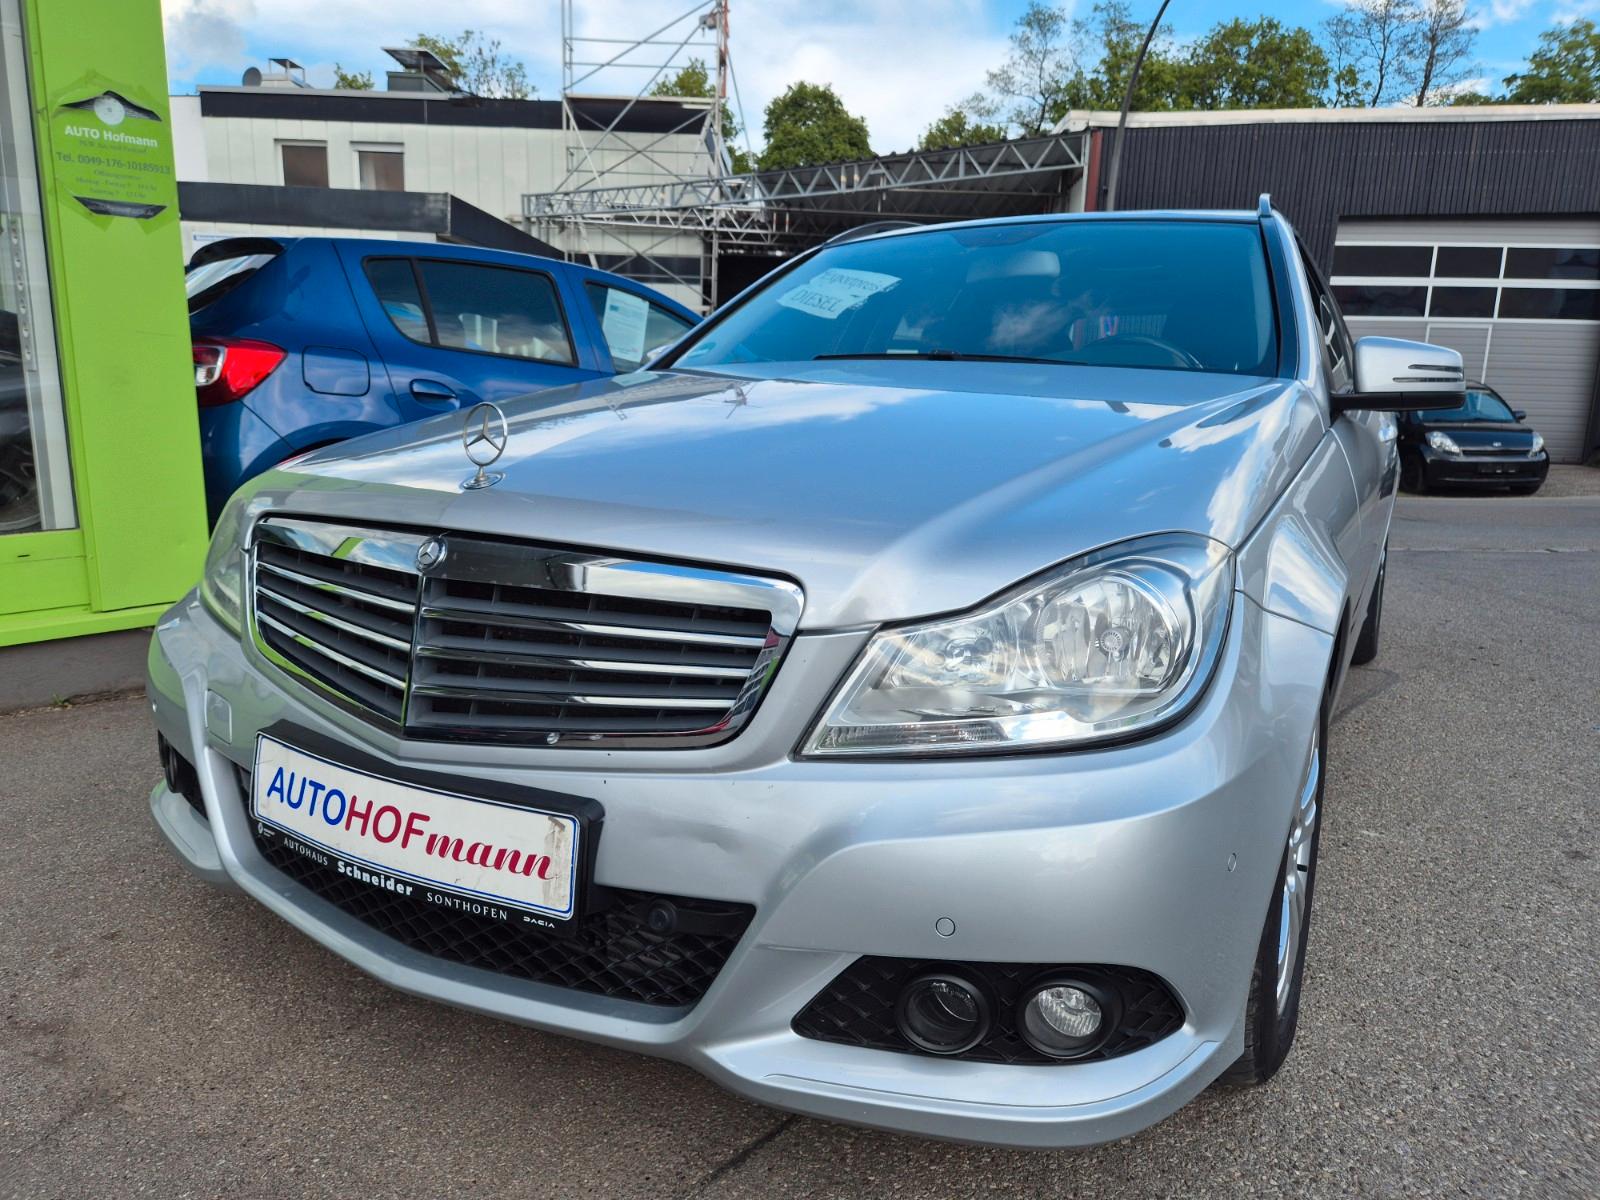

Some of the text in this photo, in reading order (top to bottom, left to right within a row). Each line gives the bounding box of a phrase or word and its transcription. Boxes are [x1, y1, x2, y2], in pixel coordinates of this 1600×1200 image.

[64, 125, 100, 139] AUTO
[103, 130, 158, 147] Hofmann
[55, 152, 74, 163] Tel.
[791, 288, 843, 313] DIESEL
[283, 837, 508, 921] AUTOHAUS Schneider SONTHOFEN
[522, 916, 556, 929] DACIA
